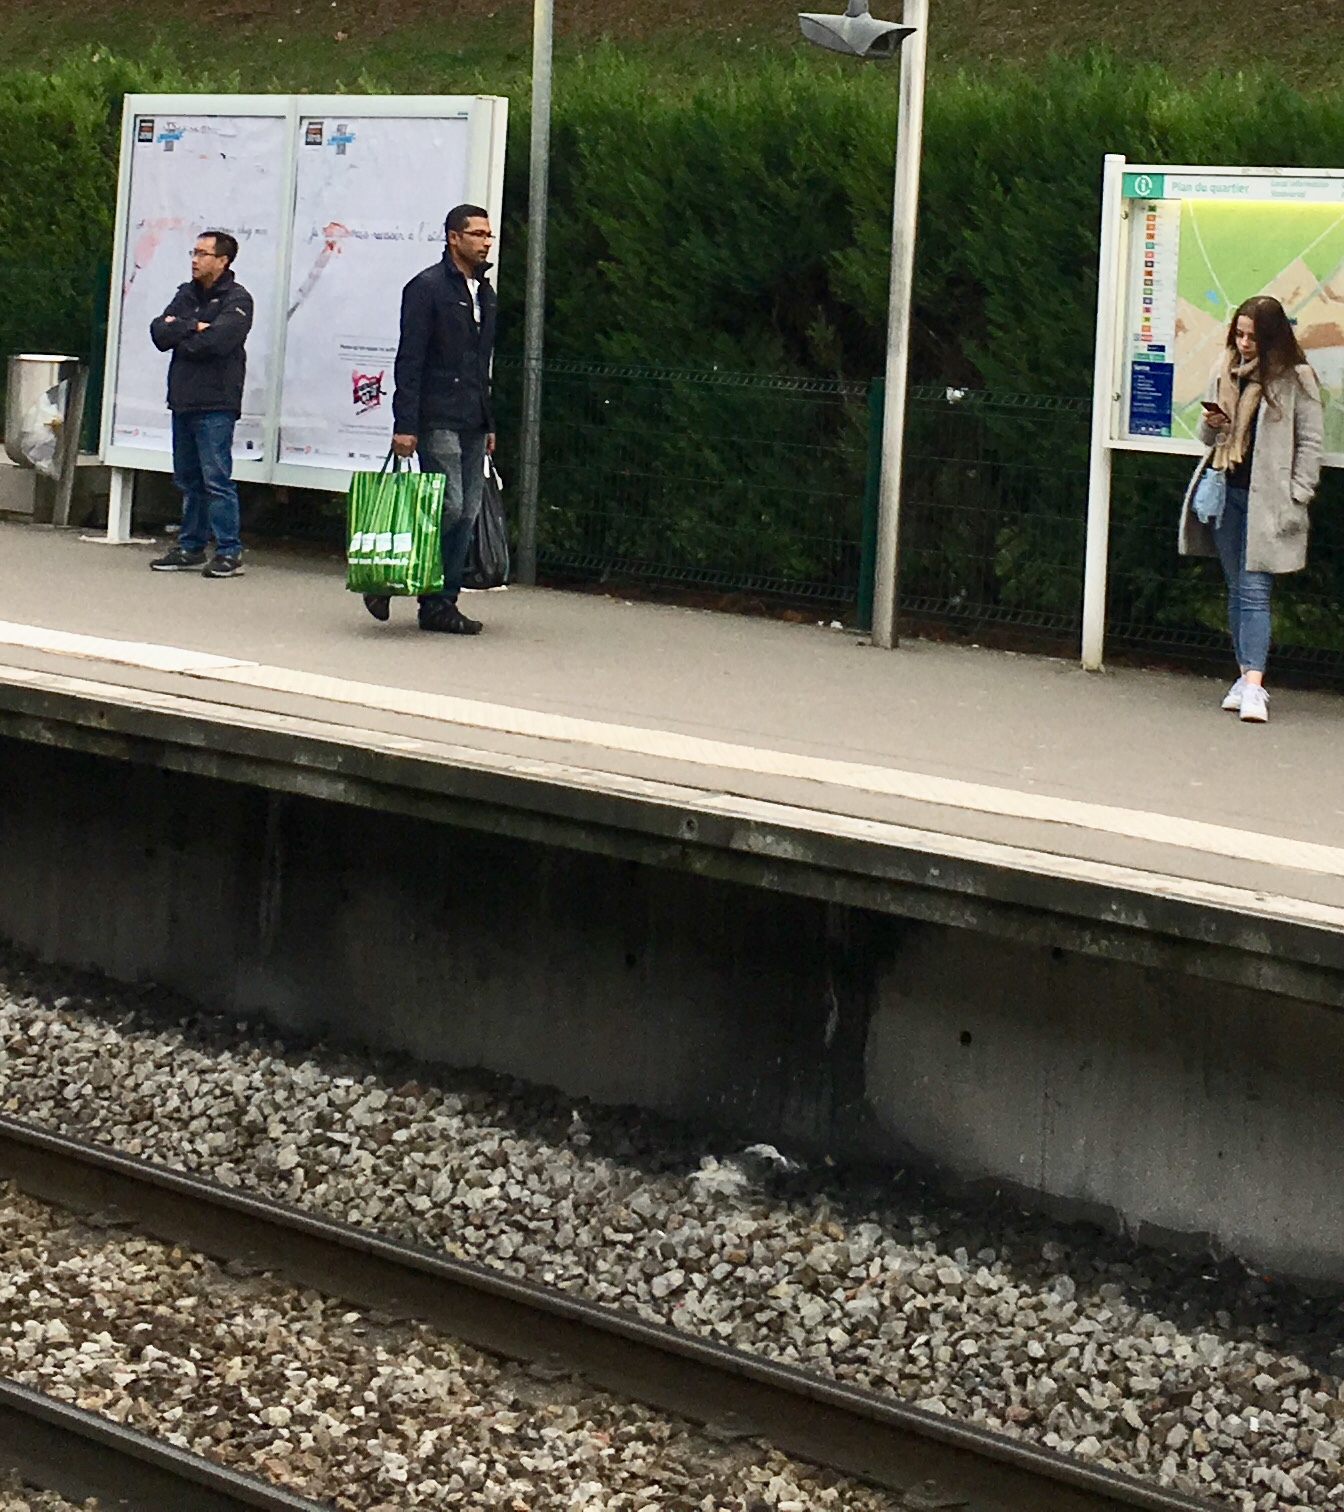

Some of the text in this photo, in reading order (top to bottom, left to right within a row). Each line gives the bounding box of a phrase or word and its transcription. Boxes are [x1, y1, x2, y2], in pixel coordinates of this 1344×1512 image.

[1171, 181, 1250, 194] Plan du quartier
